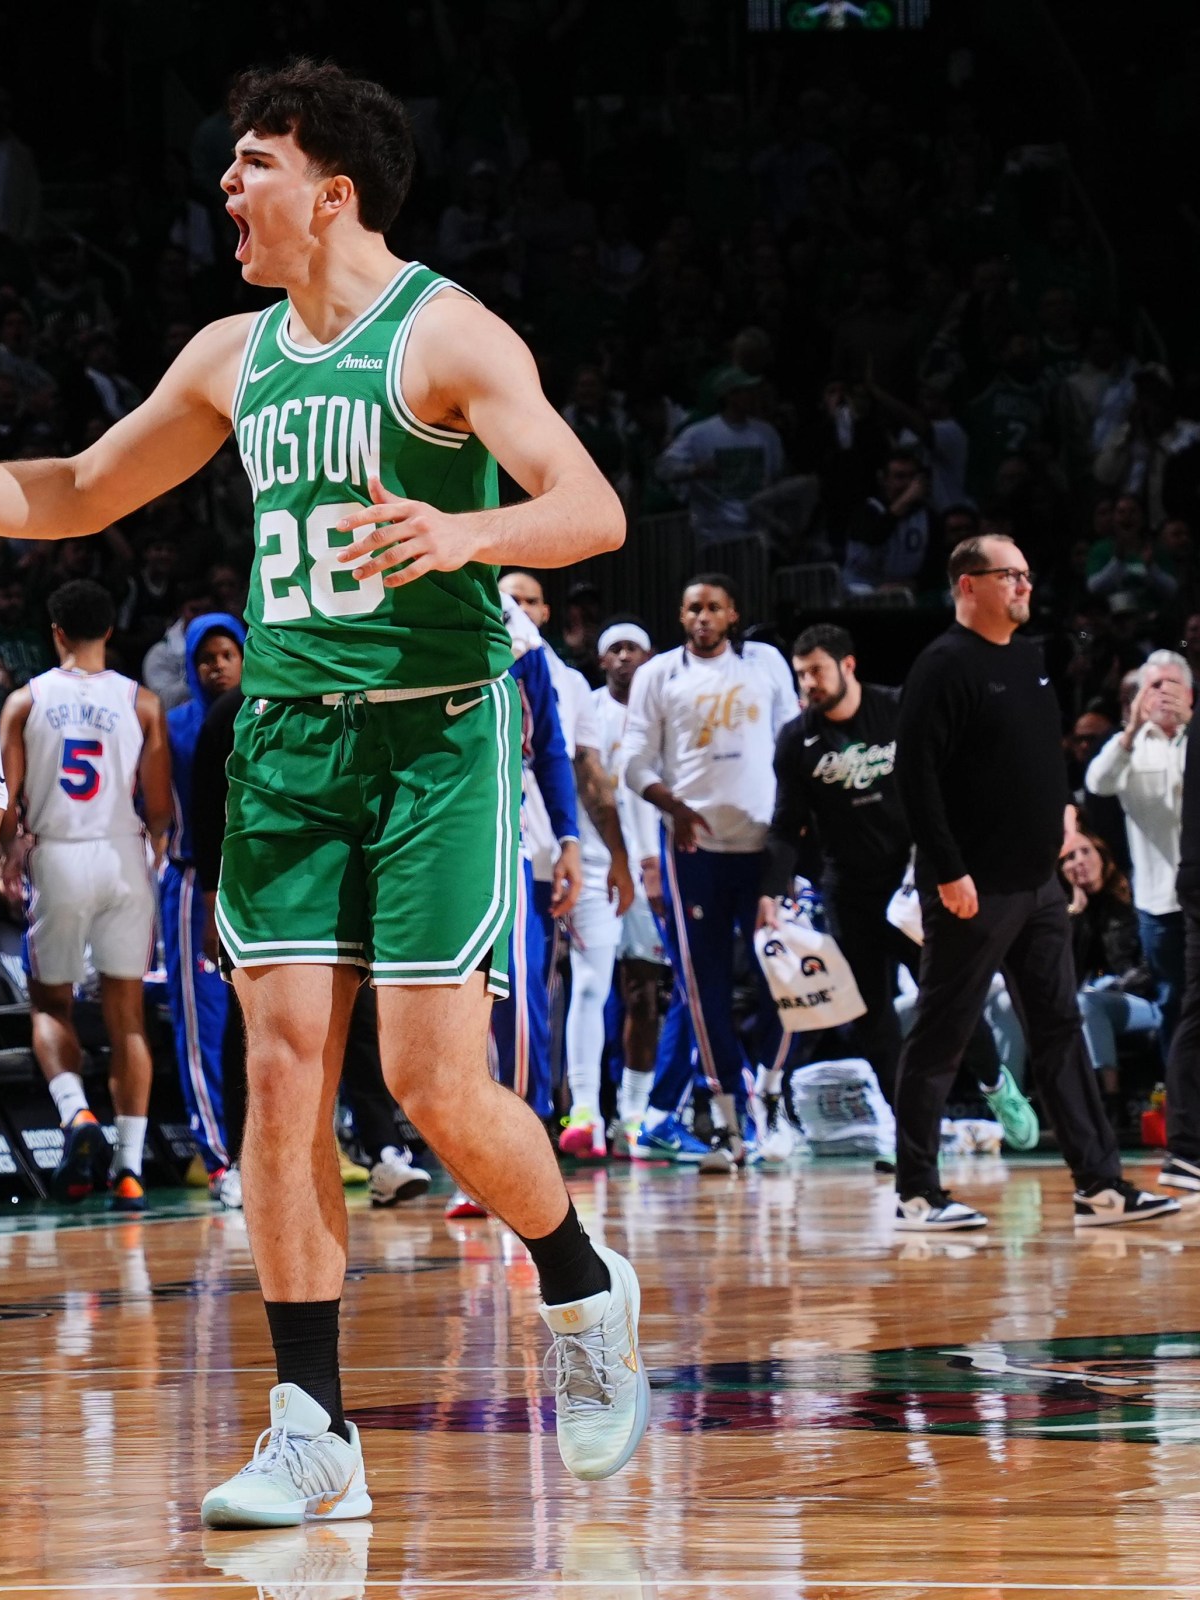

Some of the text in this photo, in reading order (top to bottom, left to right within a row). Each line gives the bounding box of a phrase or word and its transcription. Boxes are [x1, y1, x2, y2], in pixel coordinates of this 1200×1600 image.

[336, 353, 383, 370] Amica
[239, 396, 381, 504] BOSTON
[259, 502, 385, 623] 28
[46, 703, 120, 734] GRIMES
[60, 738, 103, 802] 5
[777, 988, 832, 1009] RADE
